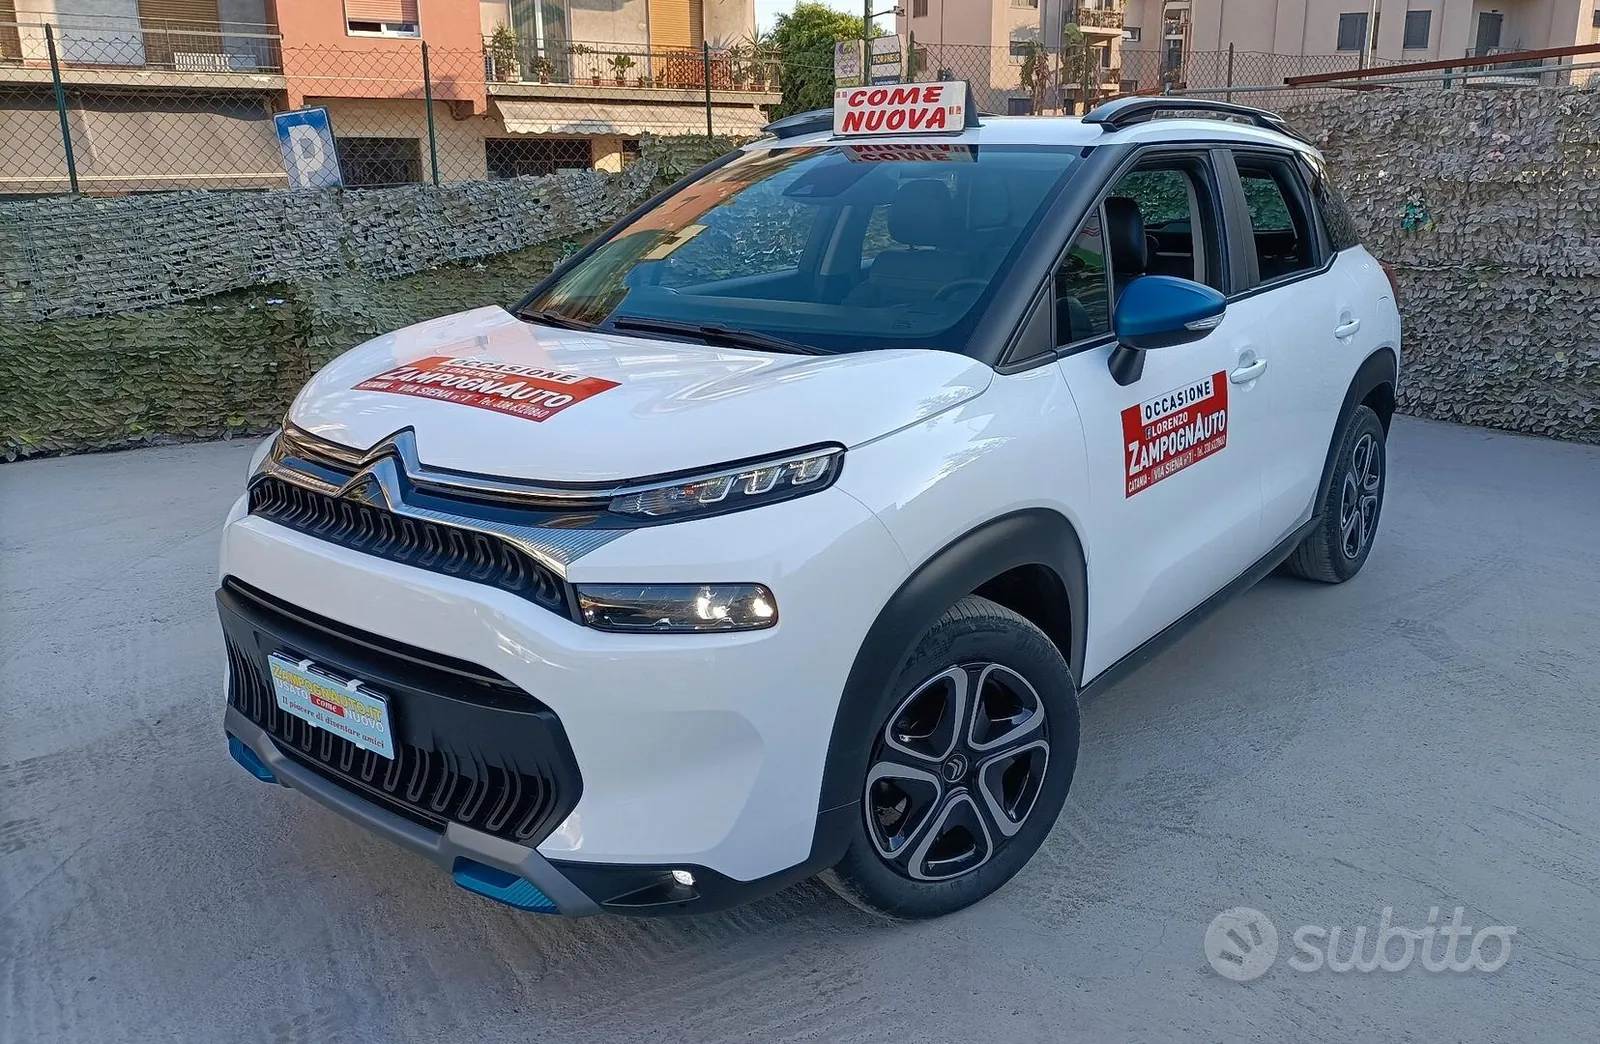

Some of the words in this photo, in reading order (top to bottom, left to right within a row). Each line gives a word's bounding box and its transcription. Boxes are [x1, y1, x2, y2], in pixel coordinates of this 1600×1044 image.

[848, 86, 944, 107] COME
[841, 106, 946, 132] NUOVA
[288, 124, 325, 188] P
[441, 366, 508, 380] LORENZO
[450, 357, 577, 382] OCCASIONE
[417, 386, 453, 399] SIENA
[1144, 380, 1212, 420] OCCASIONE
[1152, 411, 1188, 437] LORENZO
[1165, 456, 1183, 476] SIENA
[275, 678, 308, 700] USATO
[315, 697, 337, 713] come
[345, 709, 384, 733] NUOVO
[281, 695, 288, 704] Il
[289, 700, 315, 717] piacere
[315, 711, 324, 722] di
[361, 733, 386, 749] amici
